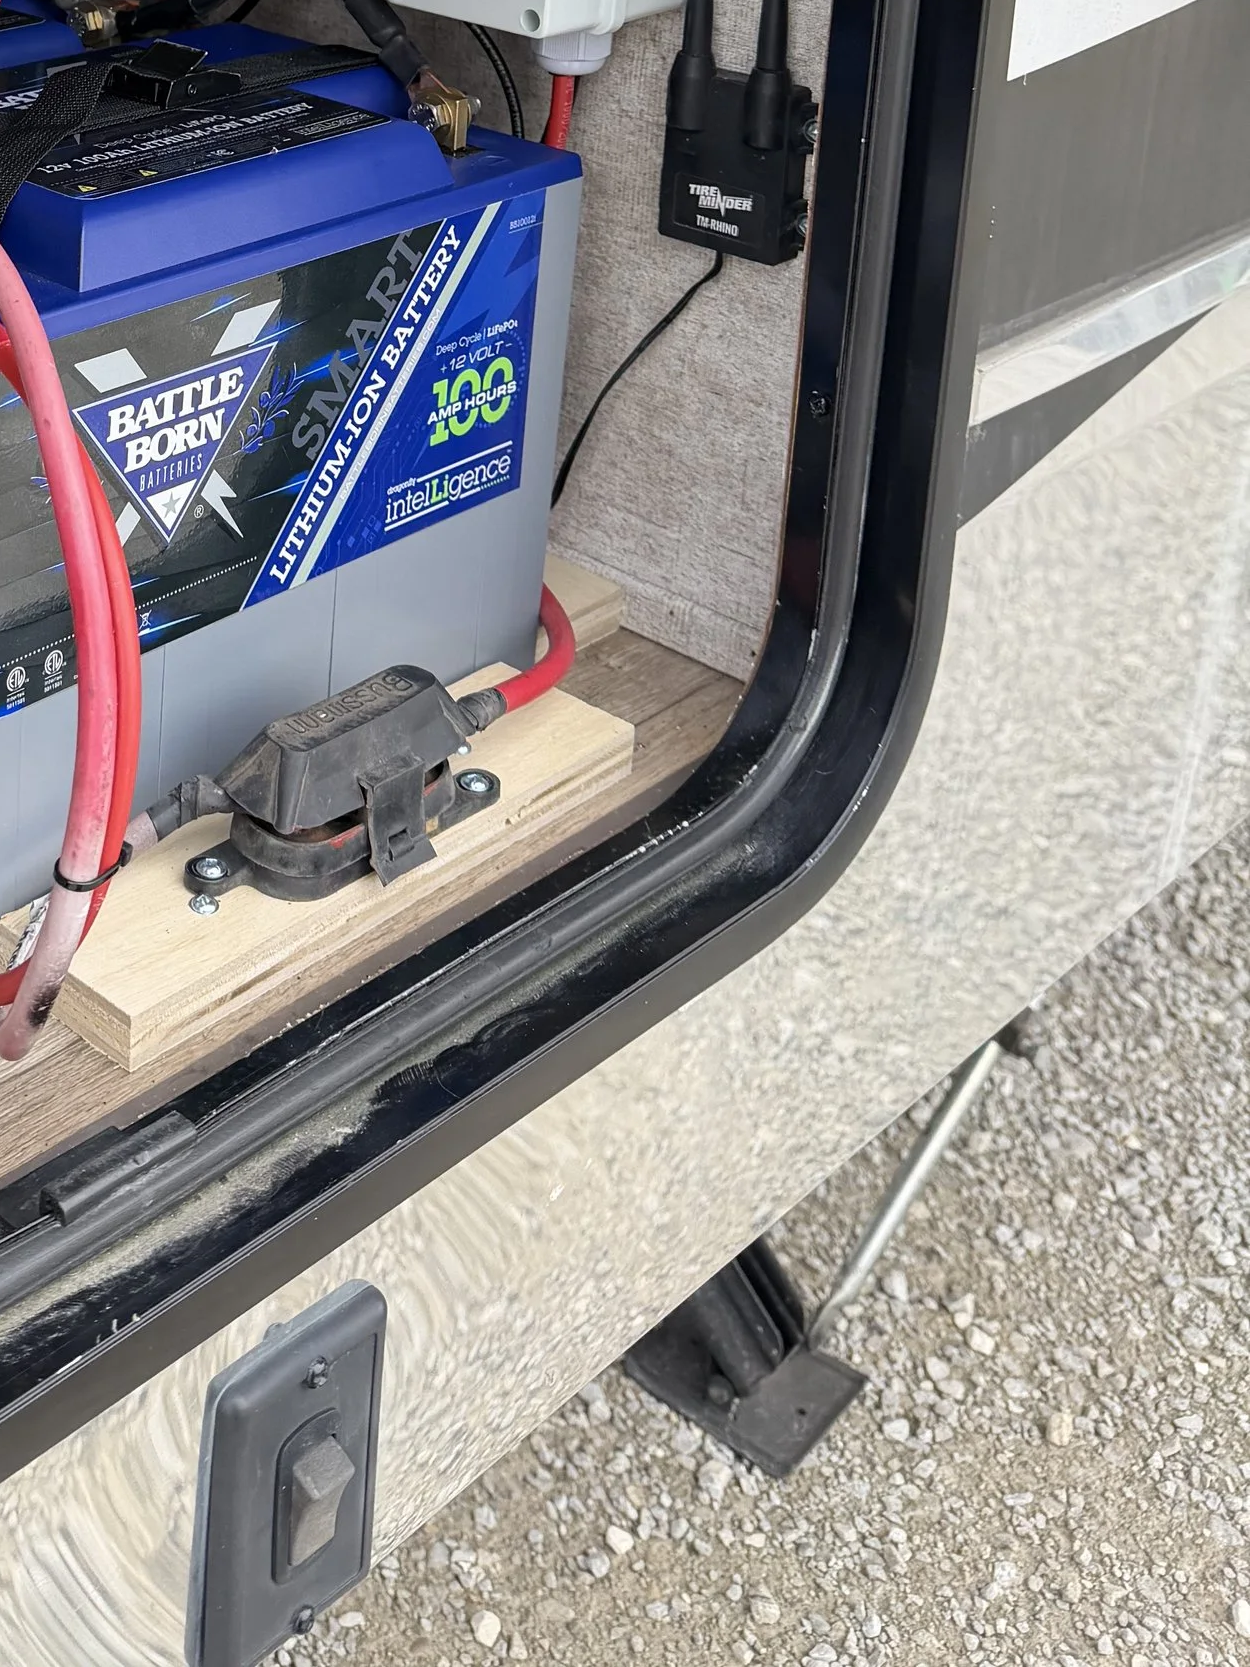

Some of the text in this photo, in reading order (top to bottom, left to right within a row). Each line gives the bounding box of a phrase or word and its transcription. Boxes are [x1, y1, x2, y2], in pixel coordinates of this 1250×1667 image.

[131, 116, 241, 155] LITHIUM-ION
[238, 102, 313, 126] BATTERY
[688, 183, 719, 200] TIRE
[698, 190, 753, 215] MINDER
[695, 214, 739, 238] TM-RHINO
[292, 228, 423, 461] SMART
[435, 342, 457, 356] Deep
[459, 332, 482, 348] Cycle
[469, 340, 504, 363] VOLT
[106, 366, 244, 443] BATTLE
[269, 224, 461, 585] LITHIUM-ION BATTERY
[427, 380, 517, 424] AMP HOURS
[429, 357, 514, 447] 100
[124, 407, 225, 473] BORN
[139, 452, 203, 492] BATTERIES
[285, 675, 413, 734] Bussmann
